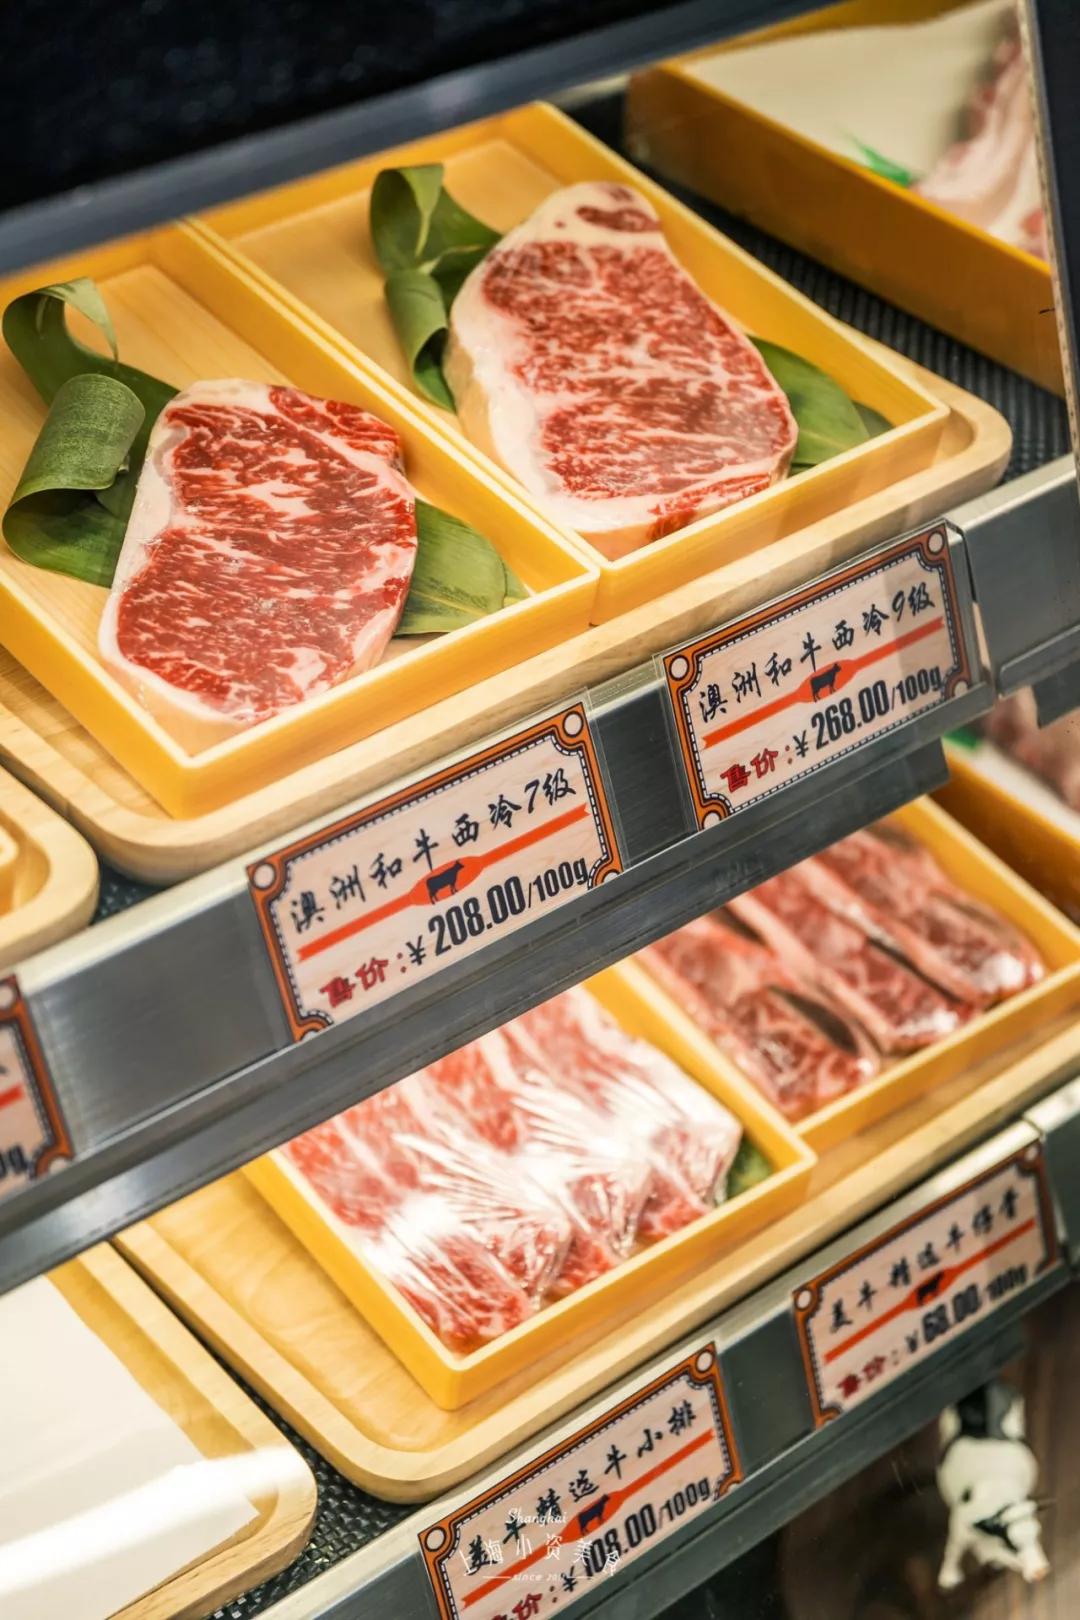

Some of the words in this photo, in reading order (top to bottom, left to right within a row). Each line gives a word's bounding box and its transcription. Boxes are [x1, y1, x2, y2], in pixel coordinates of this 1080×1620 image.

[700, 582, 935, 722] 澳洲和牛西冷9级
[290, 767, 577, 933] 澳洲和牛西冷7级
